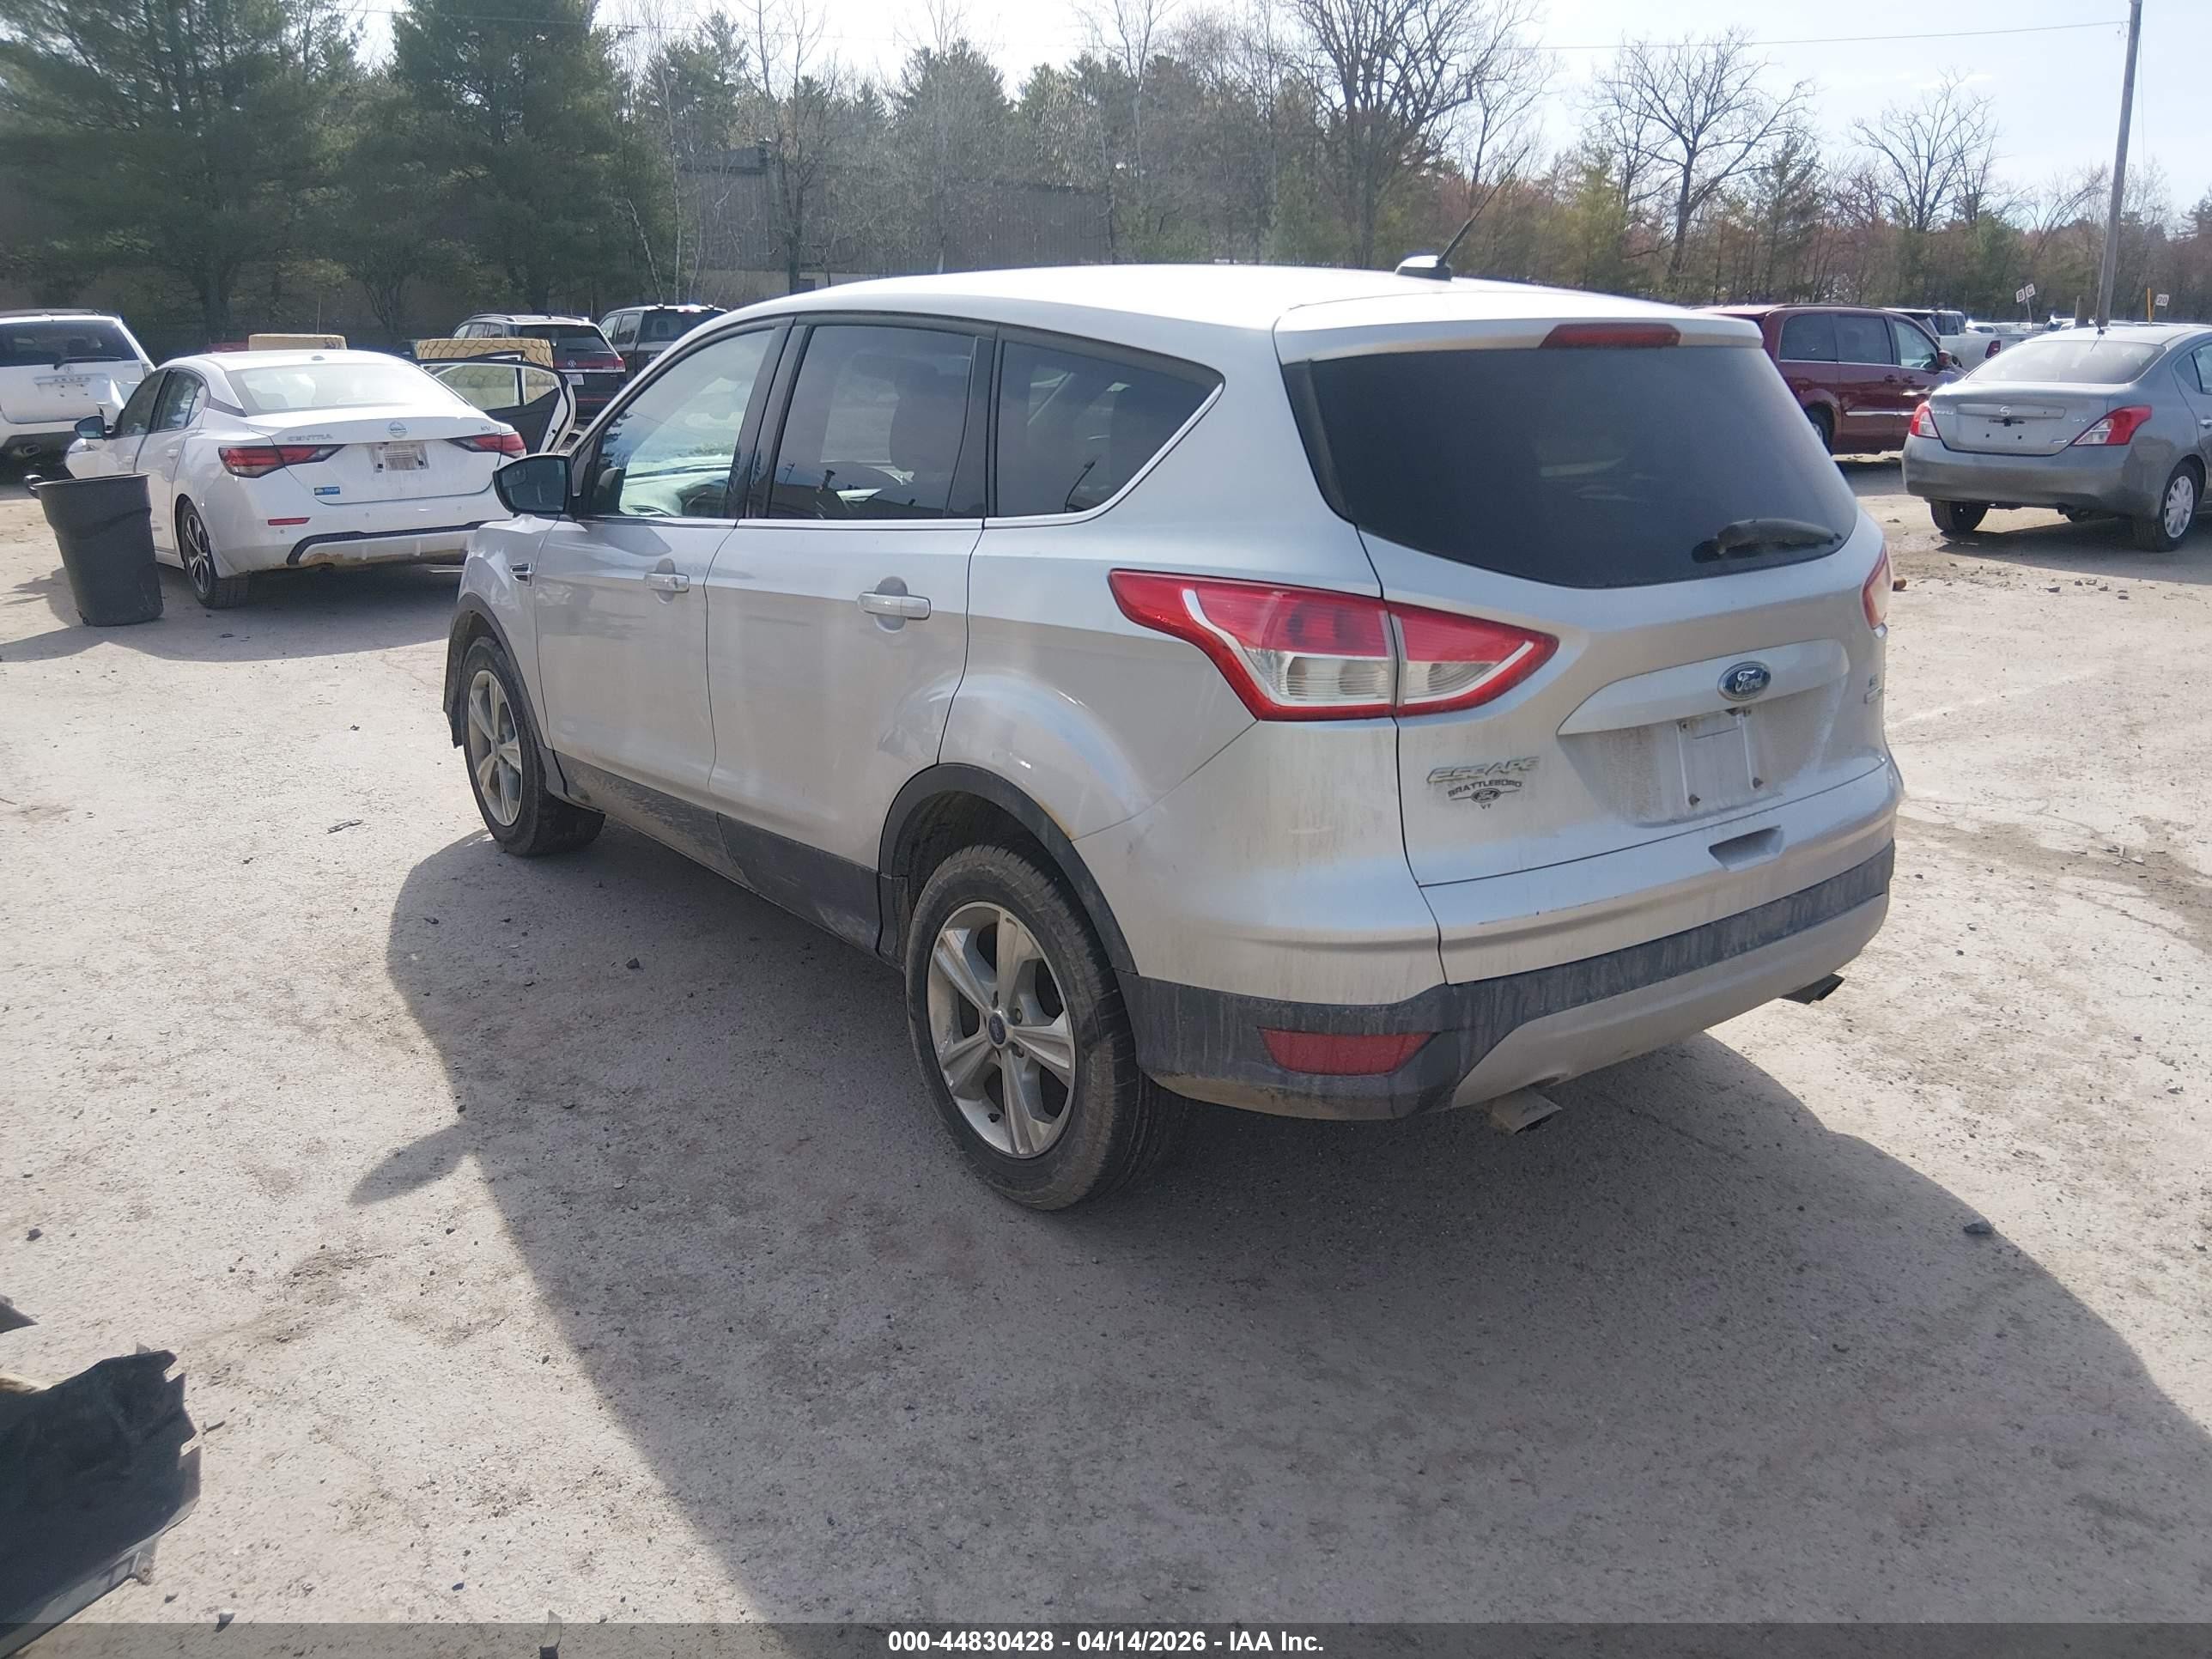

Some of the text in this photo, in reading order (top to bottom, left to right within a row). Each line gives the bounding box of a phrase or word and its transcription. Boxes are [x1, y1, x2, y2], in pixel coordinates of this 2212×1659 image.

[2017, 289, 2025, 301] B
[2027, 285, 2034, 296] C
[2157, 295, 2168, 305] 20
[1447, 778, 1522, 798] BRATTLEBORO
